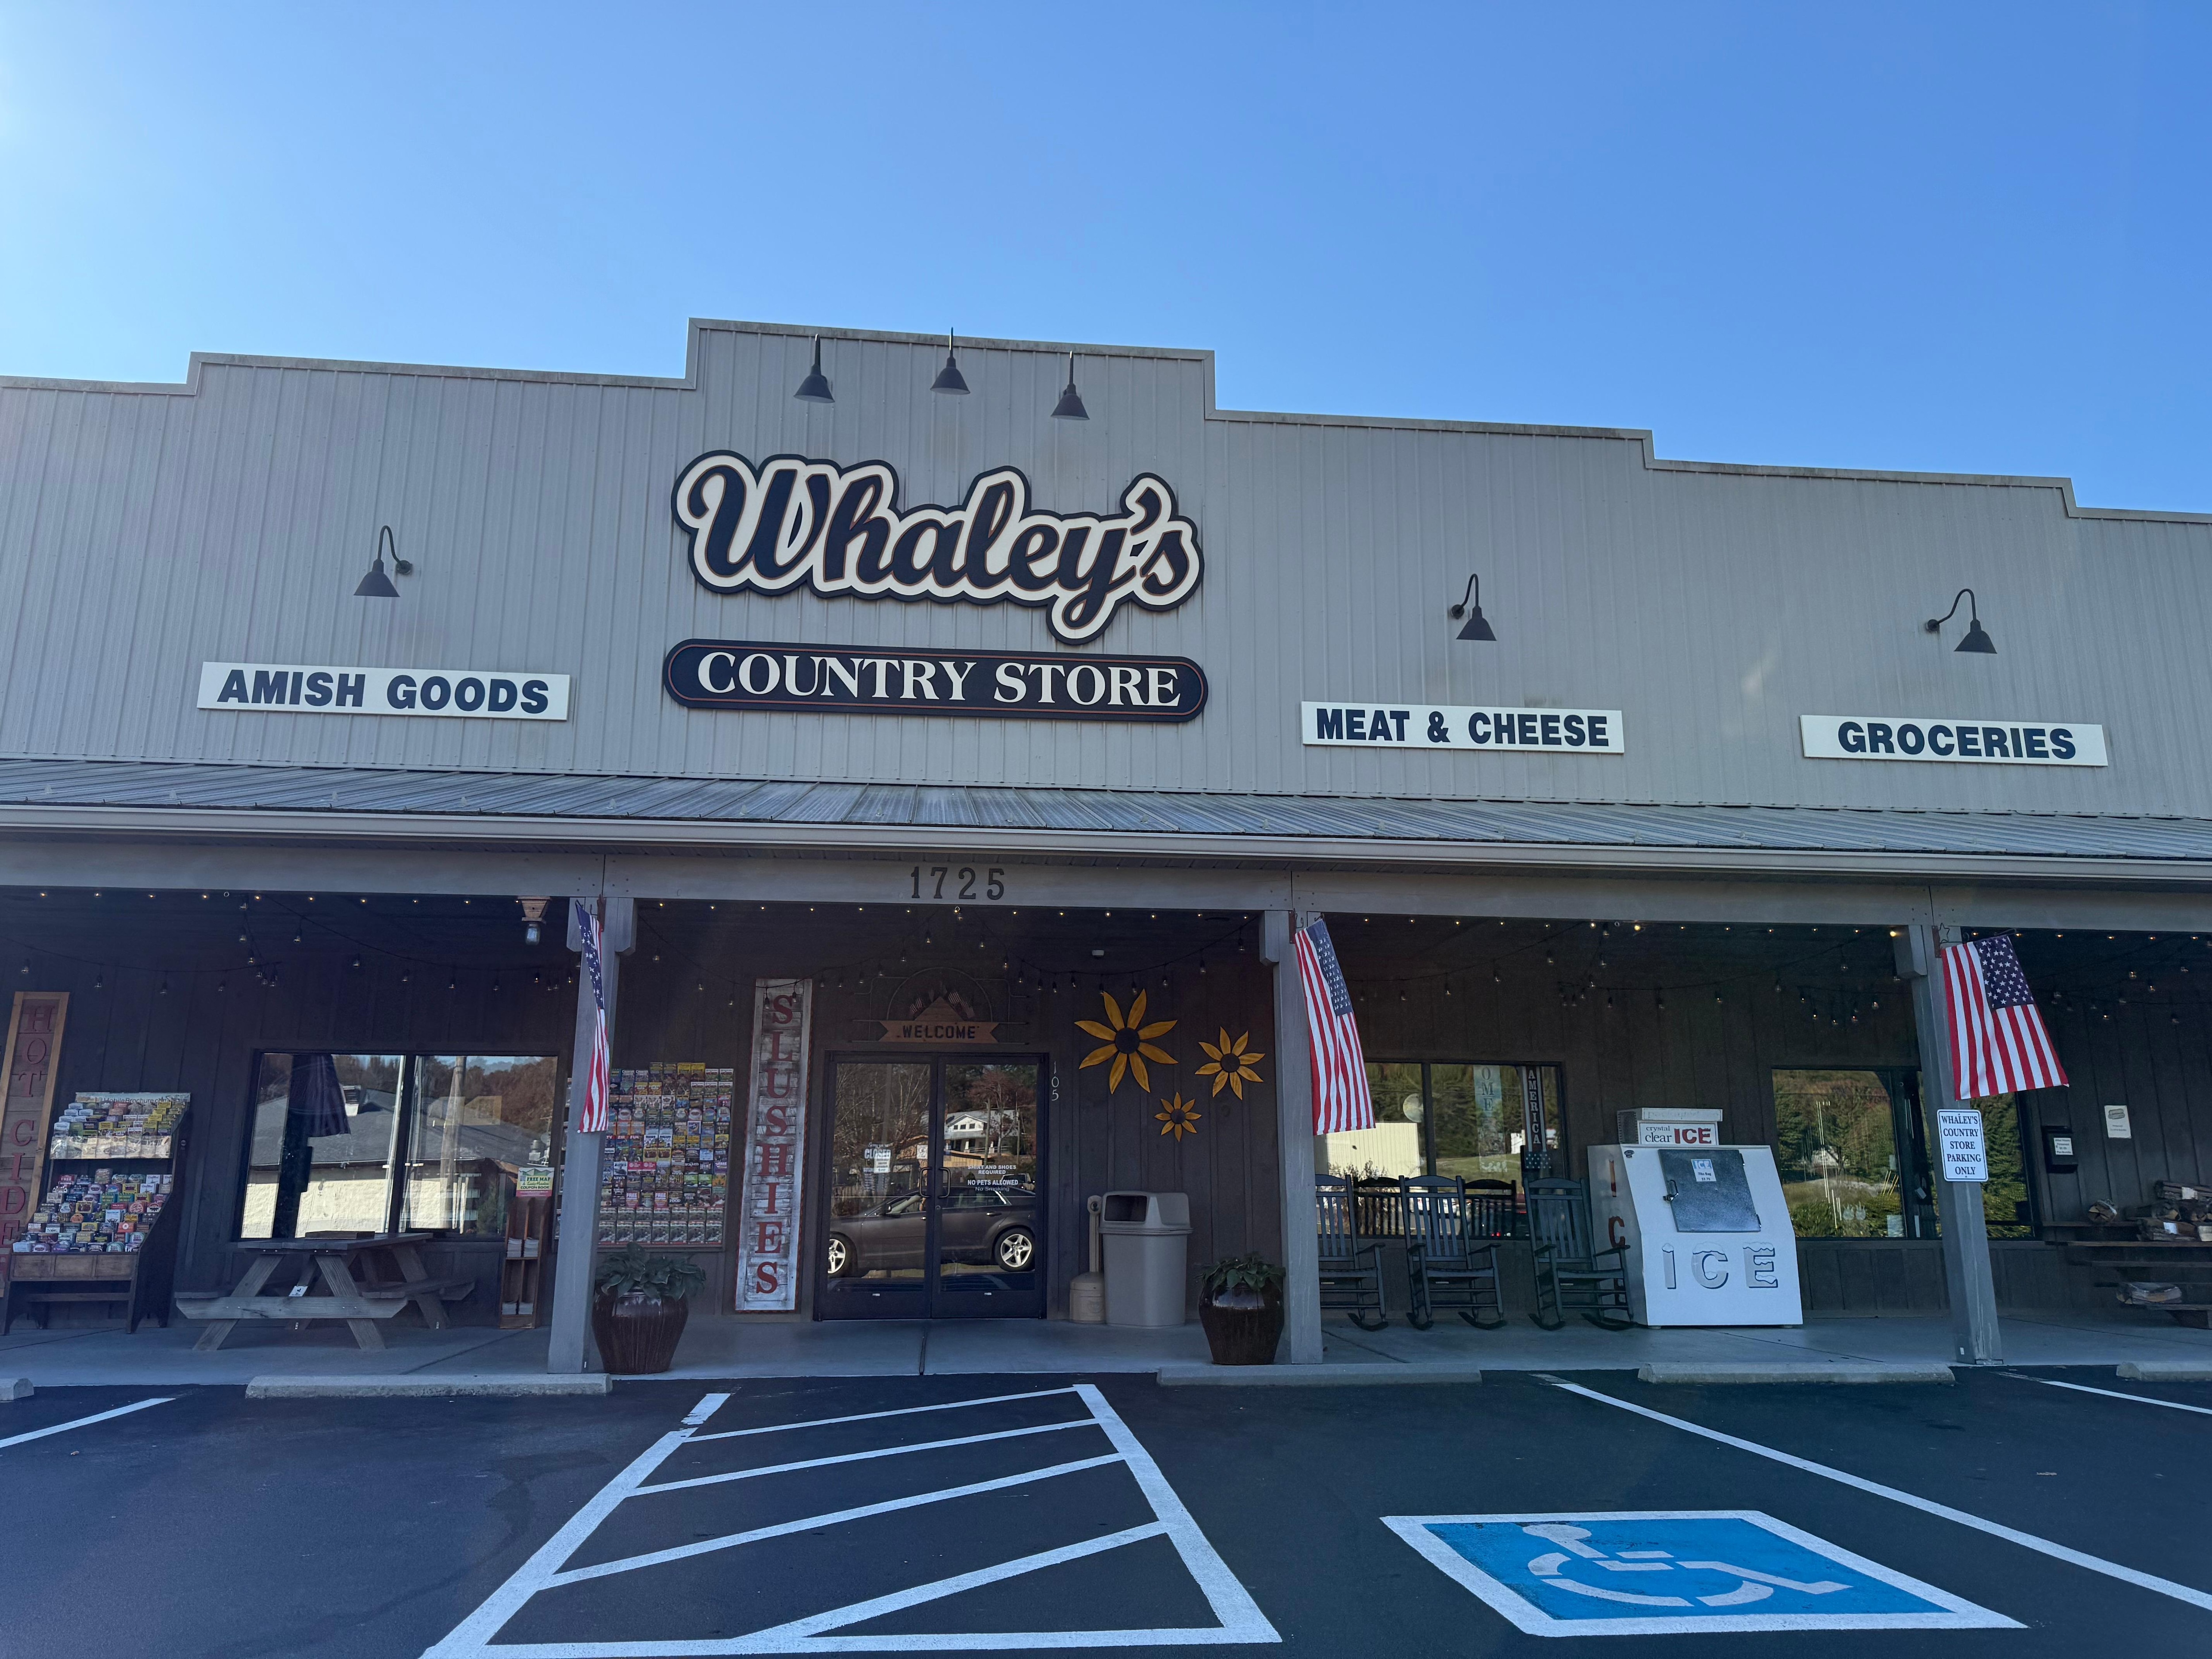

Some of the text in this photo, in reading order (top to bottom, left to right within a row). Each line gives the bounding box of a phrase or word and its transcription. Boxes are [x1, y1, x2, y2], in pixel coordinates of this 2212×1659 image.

[687, 464, 1190, 629] Whaley's
[216, 669, 549, 714] AMISH GOODS
[697, 651, 1181, 707] COUNTRY STORE
[1316, 708, 1609, 747] MEAT & CHEESE
[1838, 721, 2076, 760] GROCERIES
[910, 866, 1005, 900] 1725
[902, 1025, 975, 1039] WELCOME
[19, 1004, 56, 1098] HOT
[1528, 1069, 1541, 1144] AMERICA
[1941, 1115, 1978, 1124] WHALEY'S
[755, 994, 793, 1294] SLUSHIES
[1645, 1132, 1672, 1143] clear
[1674, 1127, 1712, 1144] ICE
[1943, 1128, 1978, 1137] COUNTRY
[1950, 1141, 1975, 1149] STORE
[864, 1148, 891, 1159] CLOSED
[1947, 1154, 1982, 1162] PARKING
[1662, 1242, 1778, 1289] ICE
